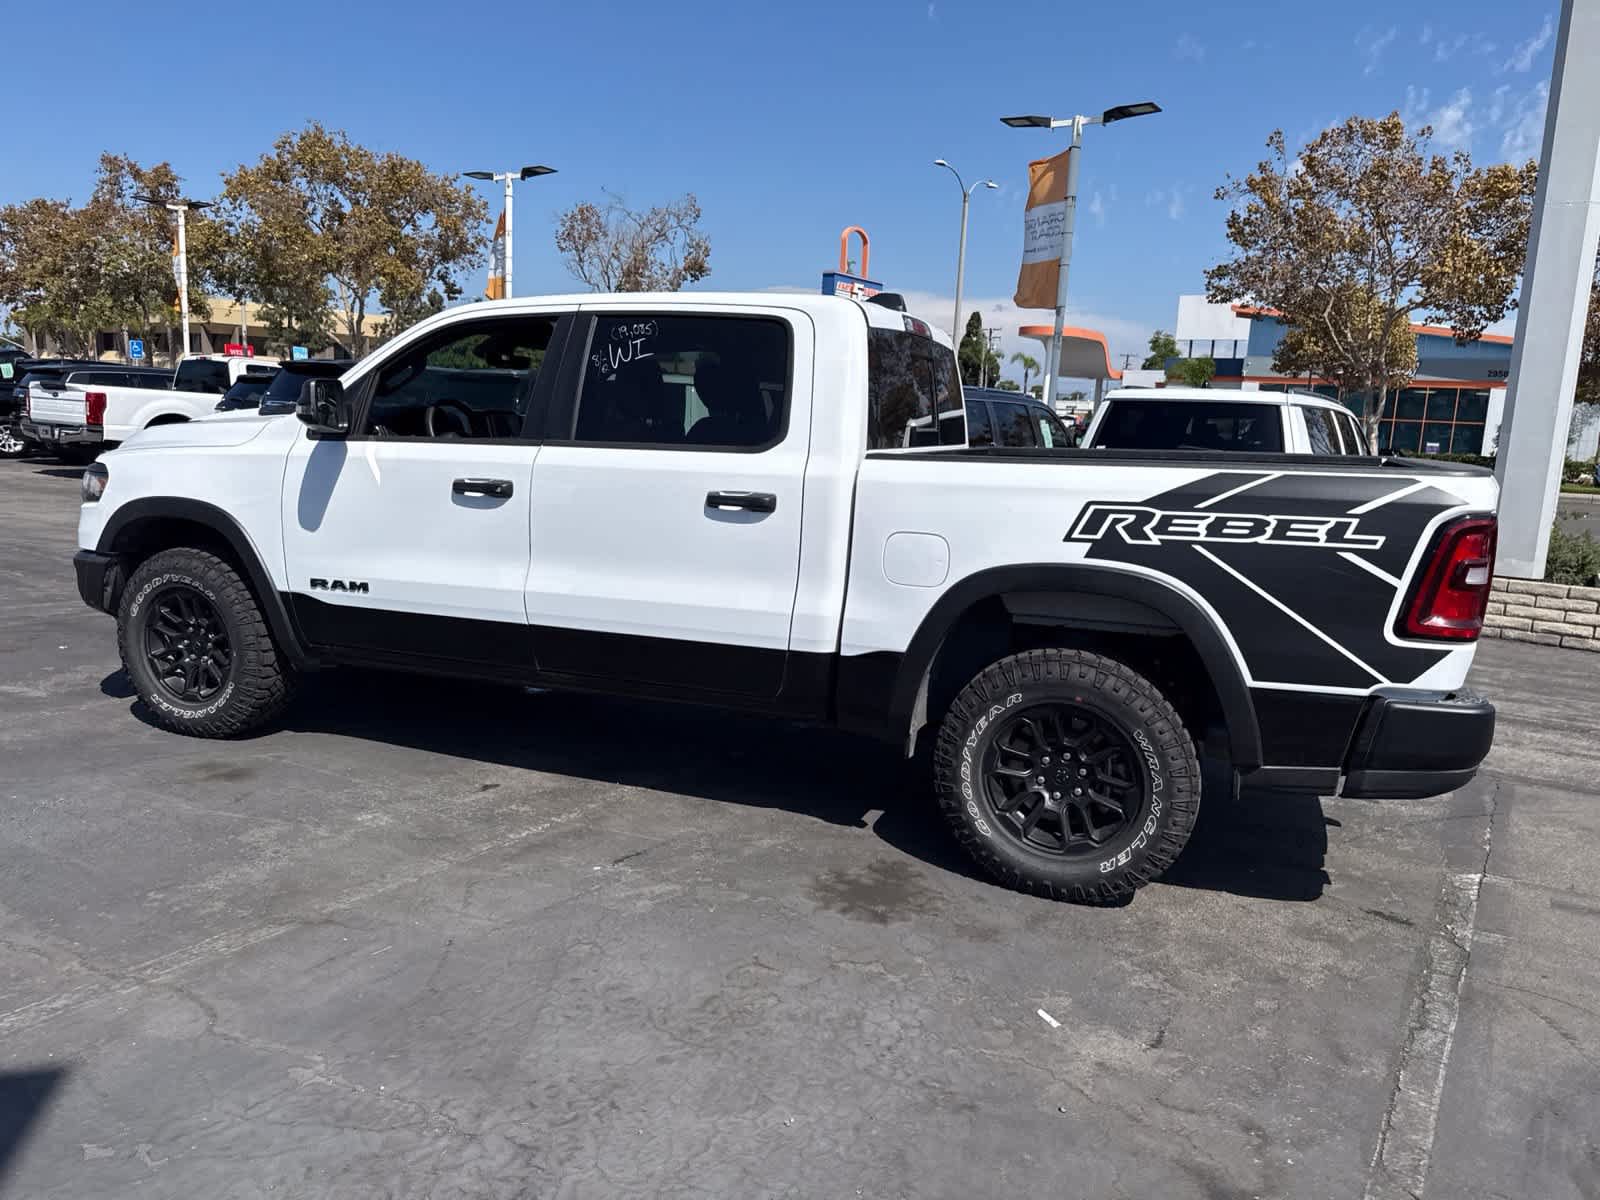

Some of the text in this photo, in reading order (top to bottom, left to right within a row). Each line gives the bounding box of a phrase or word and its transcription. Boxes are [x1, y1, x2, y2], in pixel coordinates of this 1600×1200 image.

[1070, 504, 1387, 550] REBEL
[130, 573, 216, 617] GOODYEAR
[310, 578, 370, 594] RAM
[150, 681, 235, 719] WRANGLER
[960, 693, 1023, 837] GOODYEAR
[1099, 729, 1163, 873] WRANGLER
